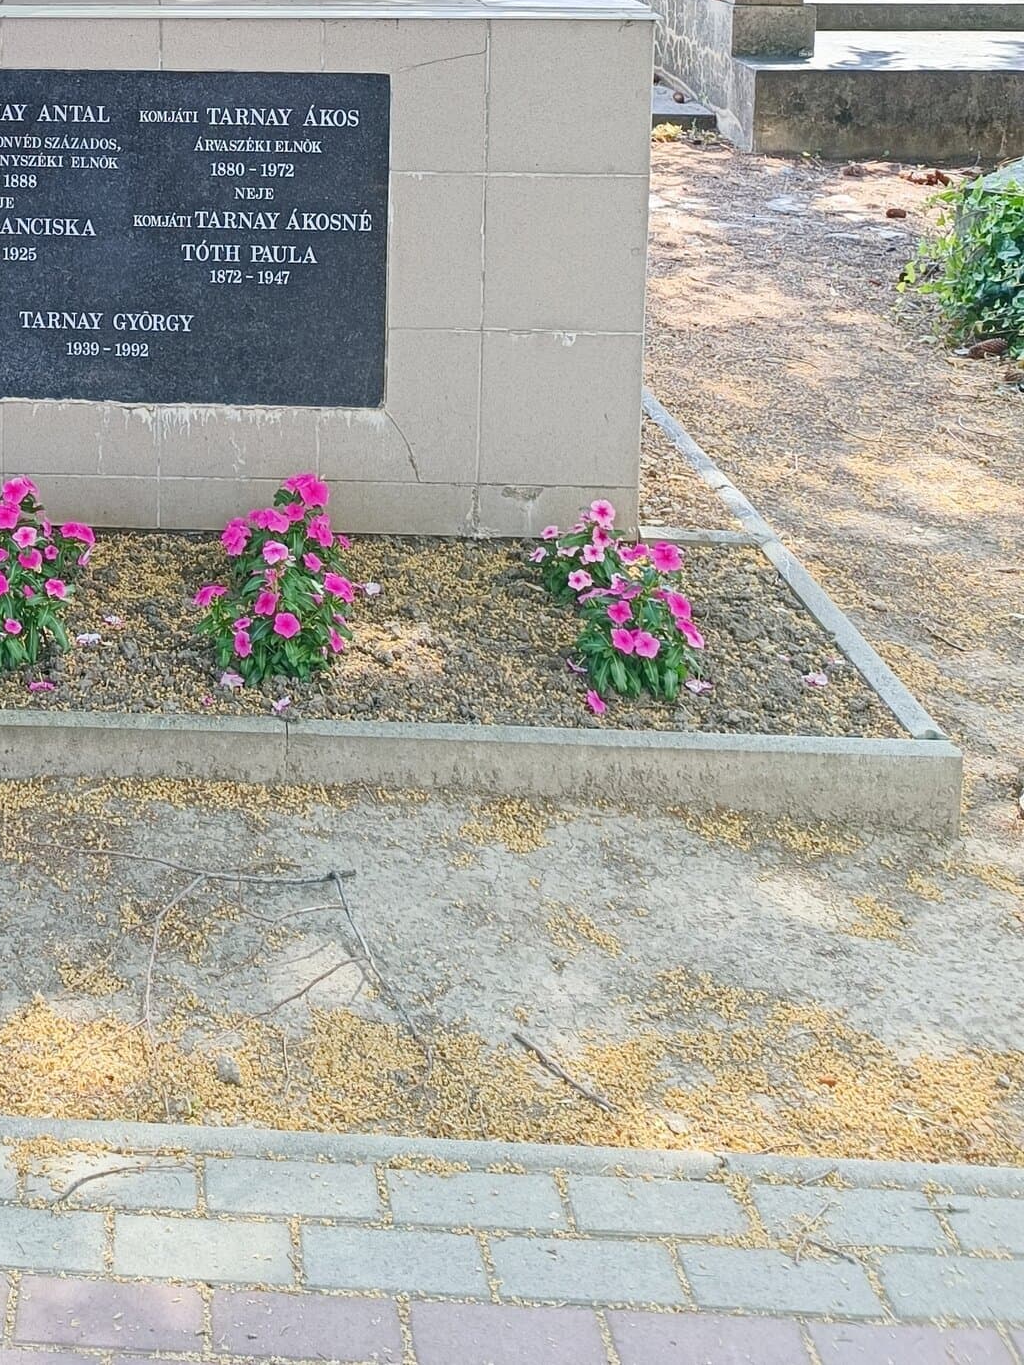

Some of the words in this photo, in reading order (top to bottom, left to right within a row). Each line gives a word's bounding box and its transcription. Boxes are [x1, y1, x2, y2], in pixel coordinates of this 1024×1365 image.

[36, 104, 111, 123] ANTAL
[139, 107, 199, 123] KOMJÁTI
[206, 107, 293, 126] TARNAY
[302, 104, 359, 127] ÁKOS
[44, 134, 122, 153] SZÁZADOS,
[193, 135, 272, 153] ÁRVASZÉKI
[274, 138, 322, 154] ELNÖK
[70, 154, 119, 169] ELNÖK
[210, 162, 245, 177] 1880
[260, 162, 295, 178] 1972
[3, 173, 38, 189] 1888
[234, 187, 274, 200] NEJE
[133, 212, 192, 228] KOMJÁTI
[194, 211, 281, 230] TARNAY
[285, 208, 372, 232] ÁKOSNÉ
[2, 246, 37, 261] 1925
[181, 239, 241, 262] TÓTH
[250, 245, 318, 264] PAULA
[209, 269, 243, 284] 1872
[257, 270, 291, 285] 1947
[19, 311, 104, 330] TARNAY
[112, 310, 195, 332] GYÖRGY
[66, 341, 100, 356] 1939
[114, 342, 149, 357] 1992
